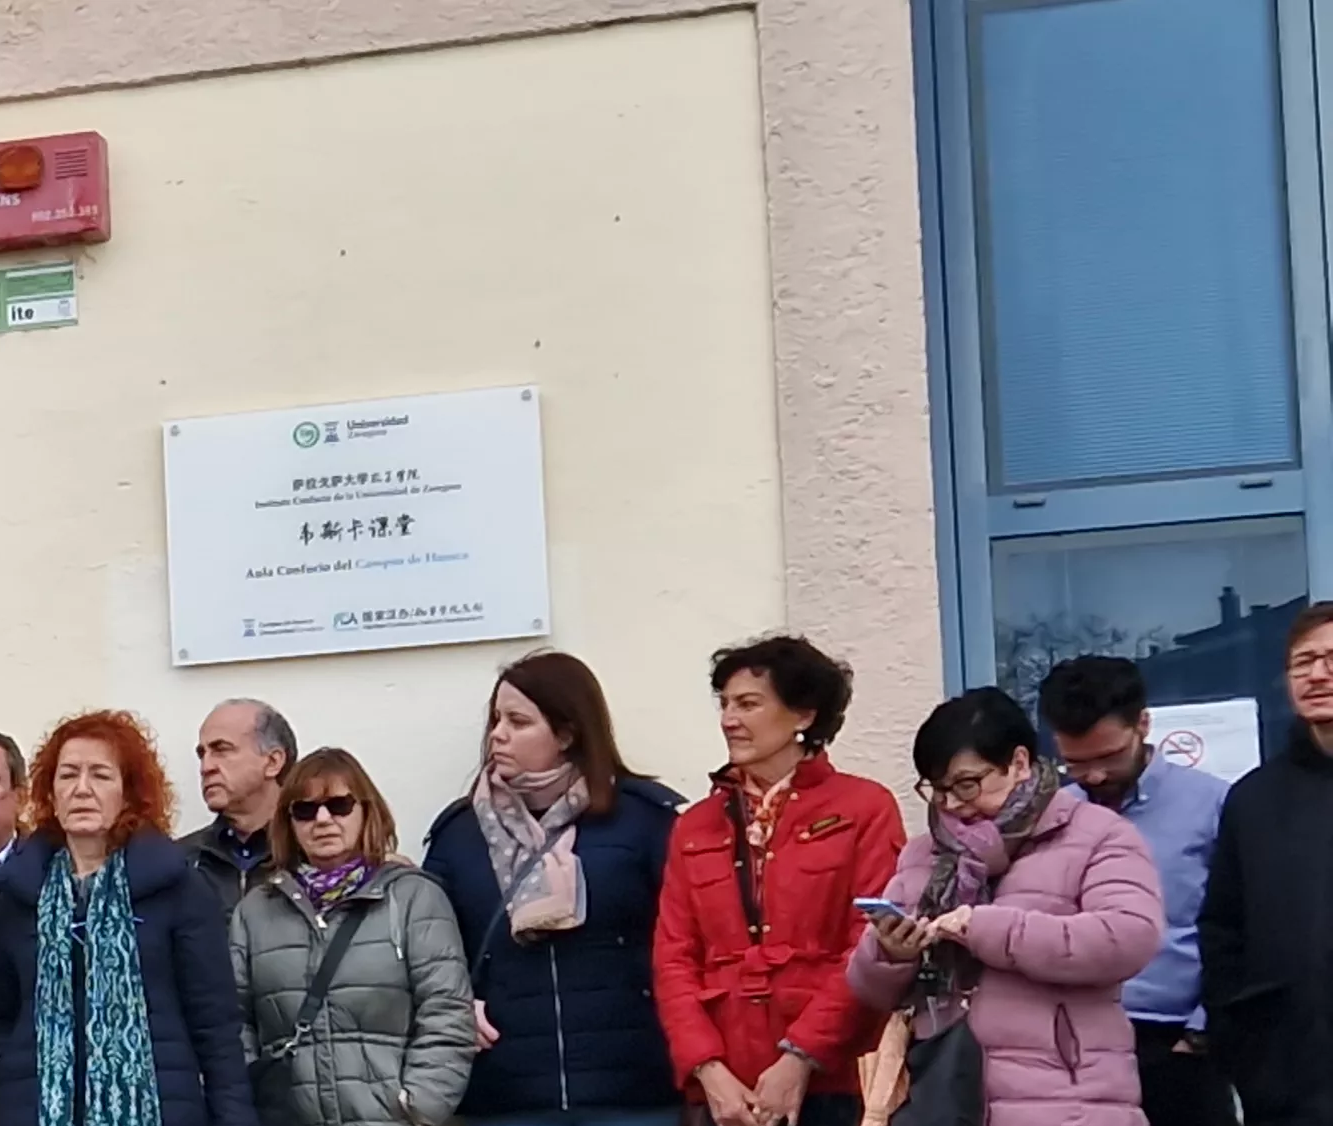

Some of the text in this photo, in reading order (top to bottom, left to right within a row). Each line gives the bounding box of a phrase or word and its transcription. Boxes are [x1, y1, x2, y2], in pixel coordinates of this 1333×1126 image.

[245, 568, 274, 579] Aula
[276, 563, 331, 576] Confucio
[333, 560, 352, 570] del
